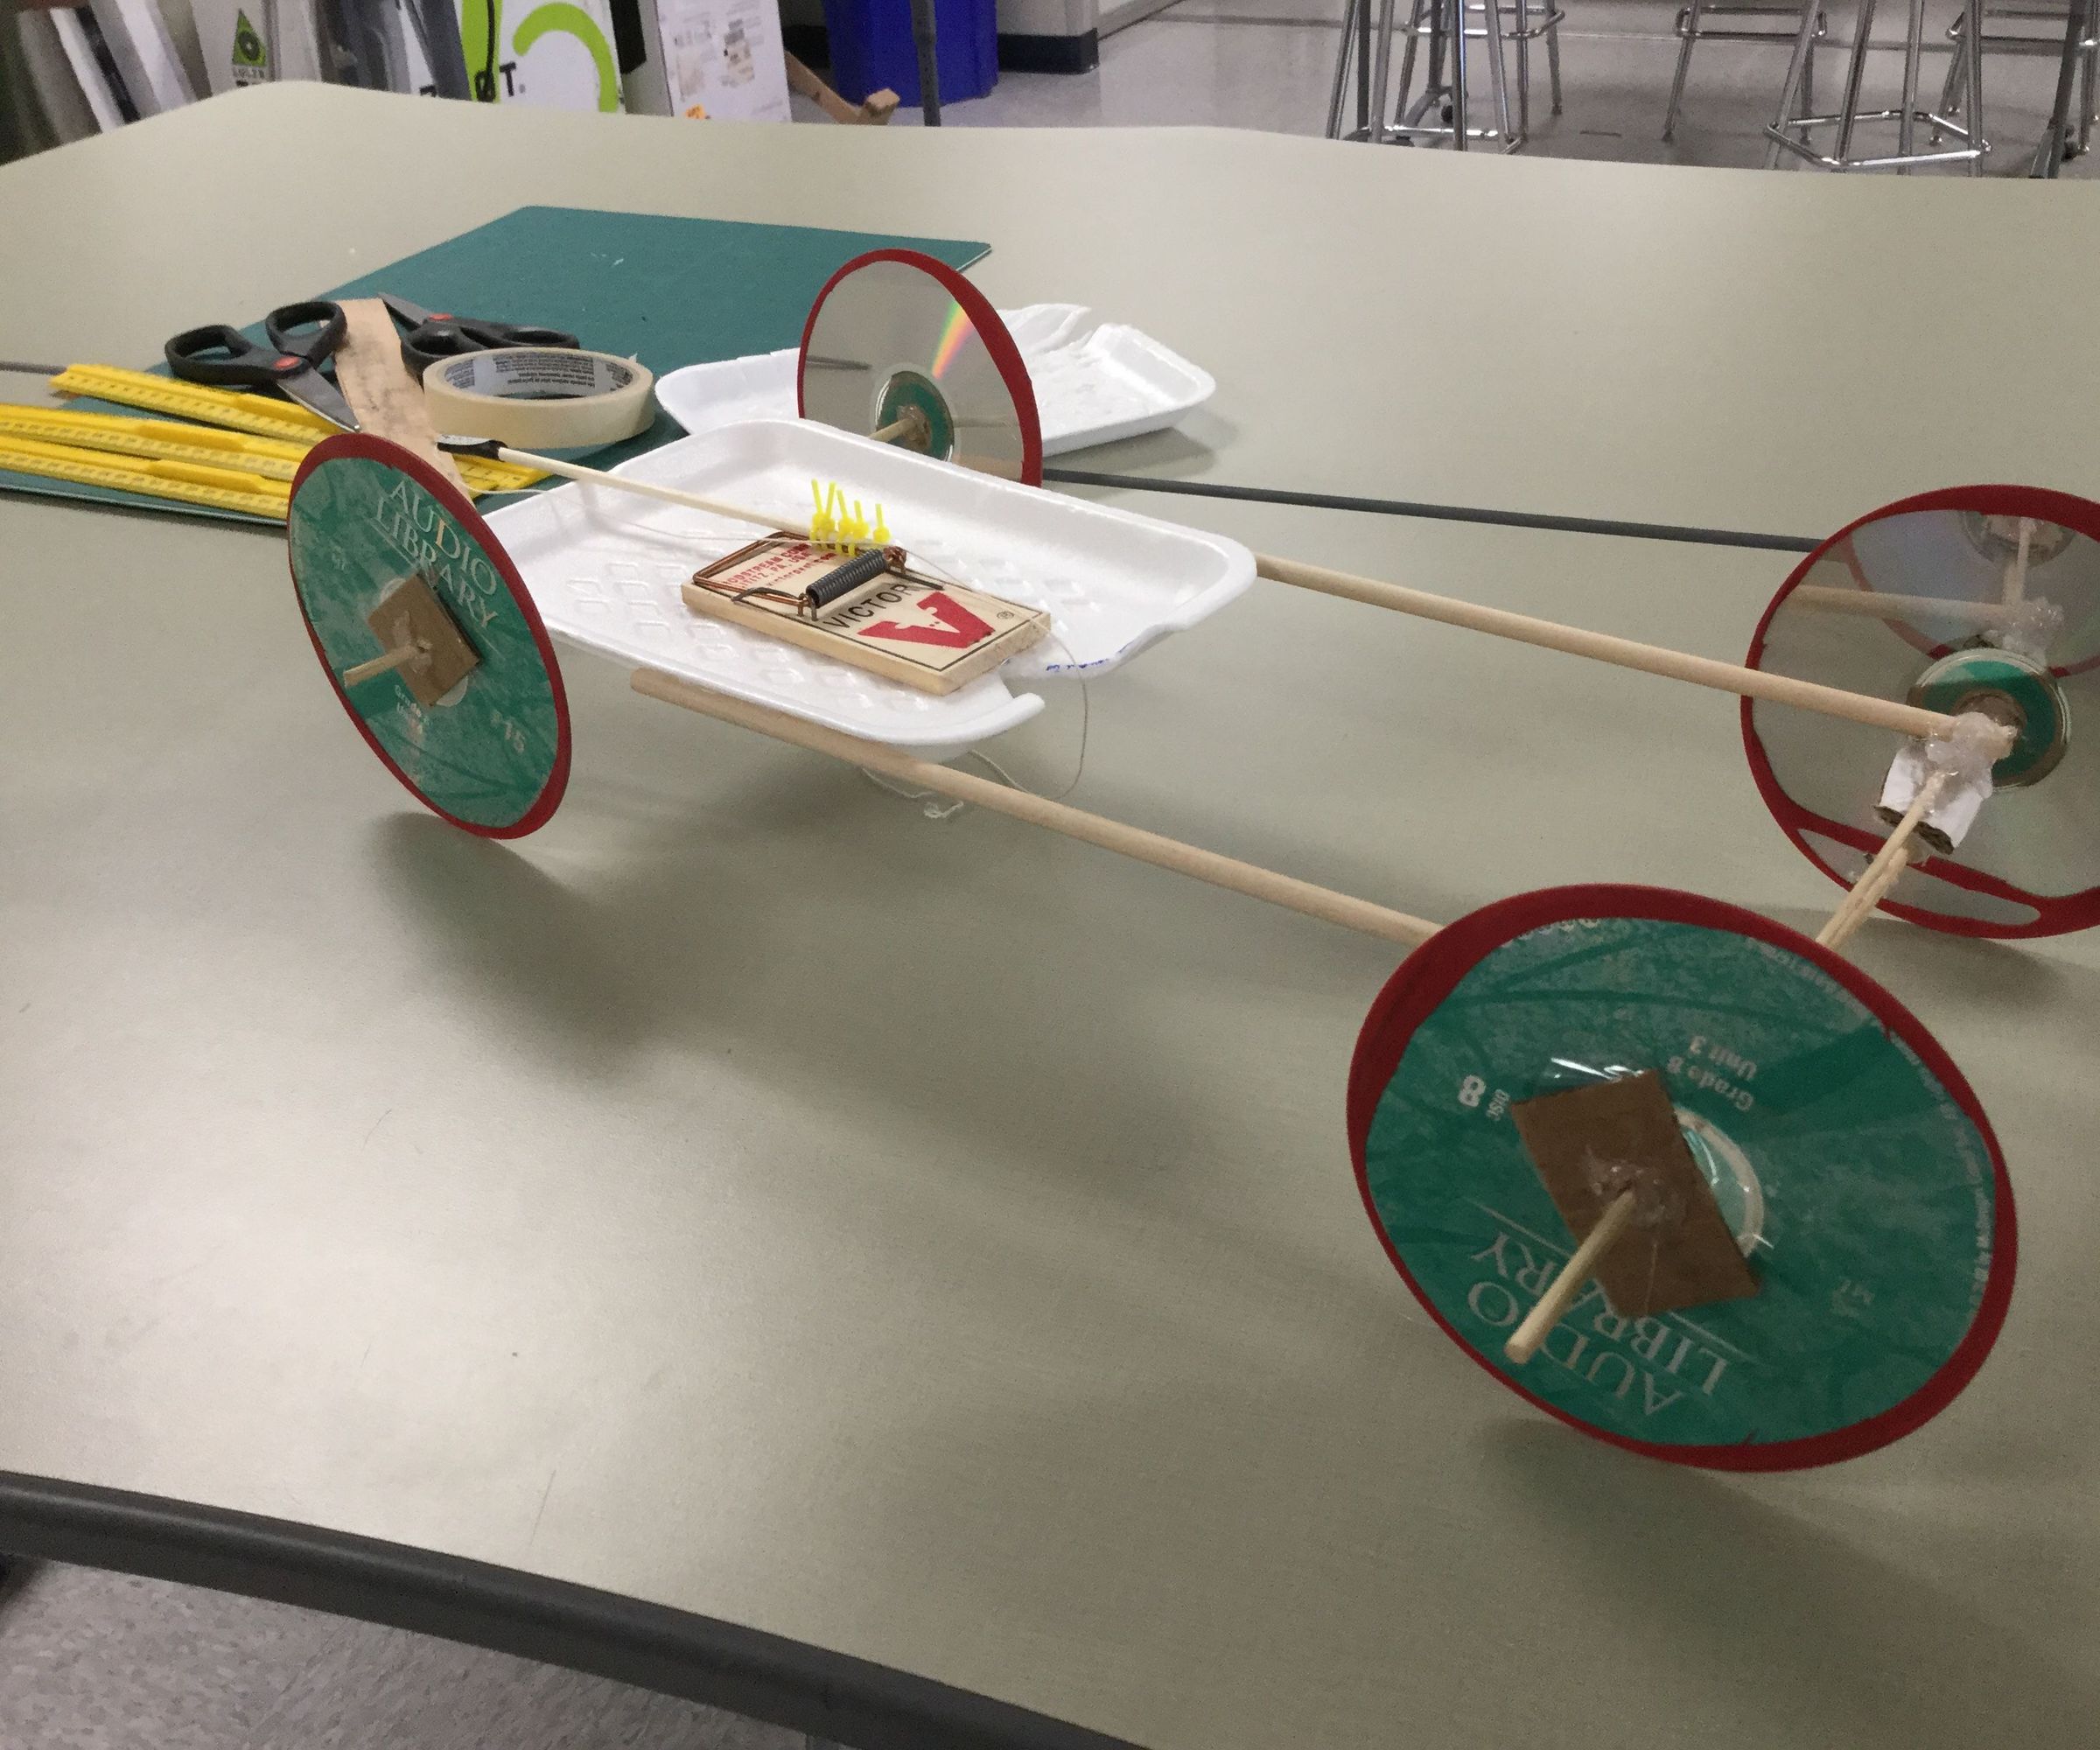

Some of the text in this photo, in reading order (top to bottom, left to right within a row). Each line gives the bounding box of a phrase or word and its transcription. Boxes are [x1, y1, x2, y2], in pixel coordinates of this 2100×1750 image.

[390, 480, 497, 596] AUDIO
[376, 496, 498, 628] LIBRARY
[822, 584, 914, 629] VICTOR
[1708, 1045, 1758, 1082] Unit
[1456, 1074, 1487, 1108] 8
[1686, 1065, 1754, 1111] Grade
[1467, 1281, 1684, 1415] AUDO
